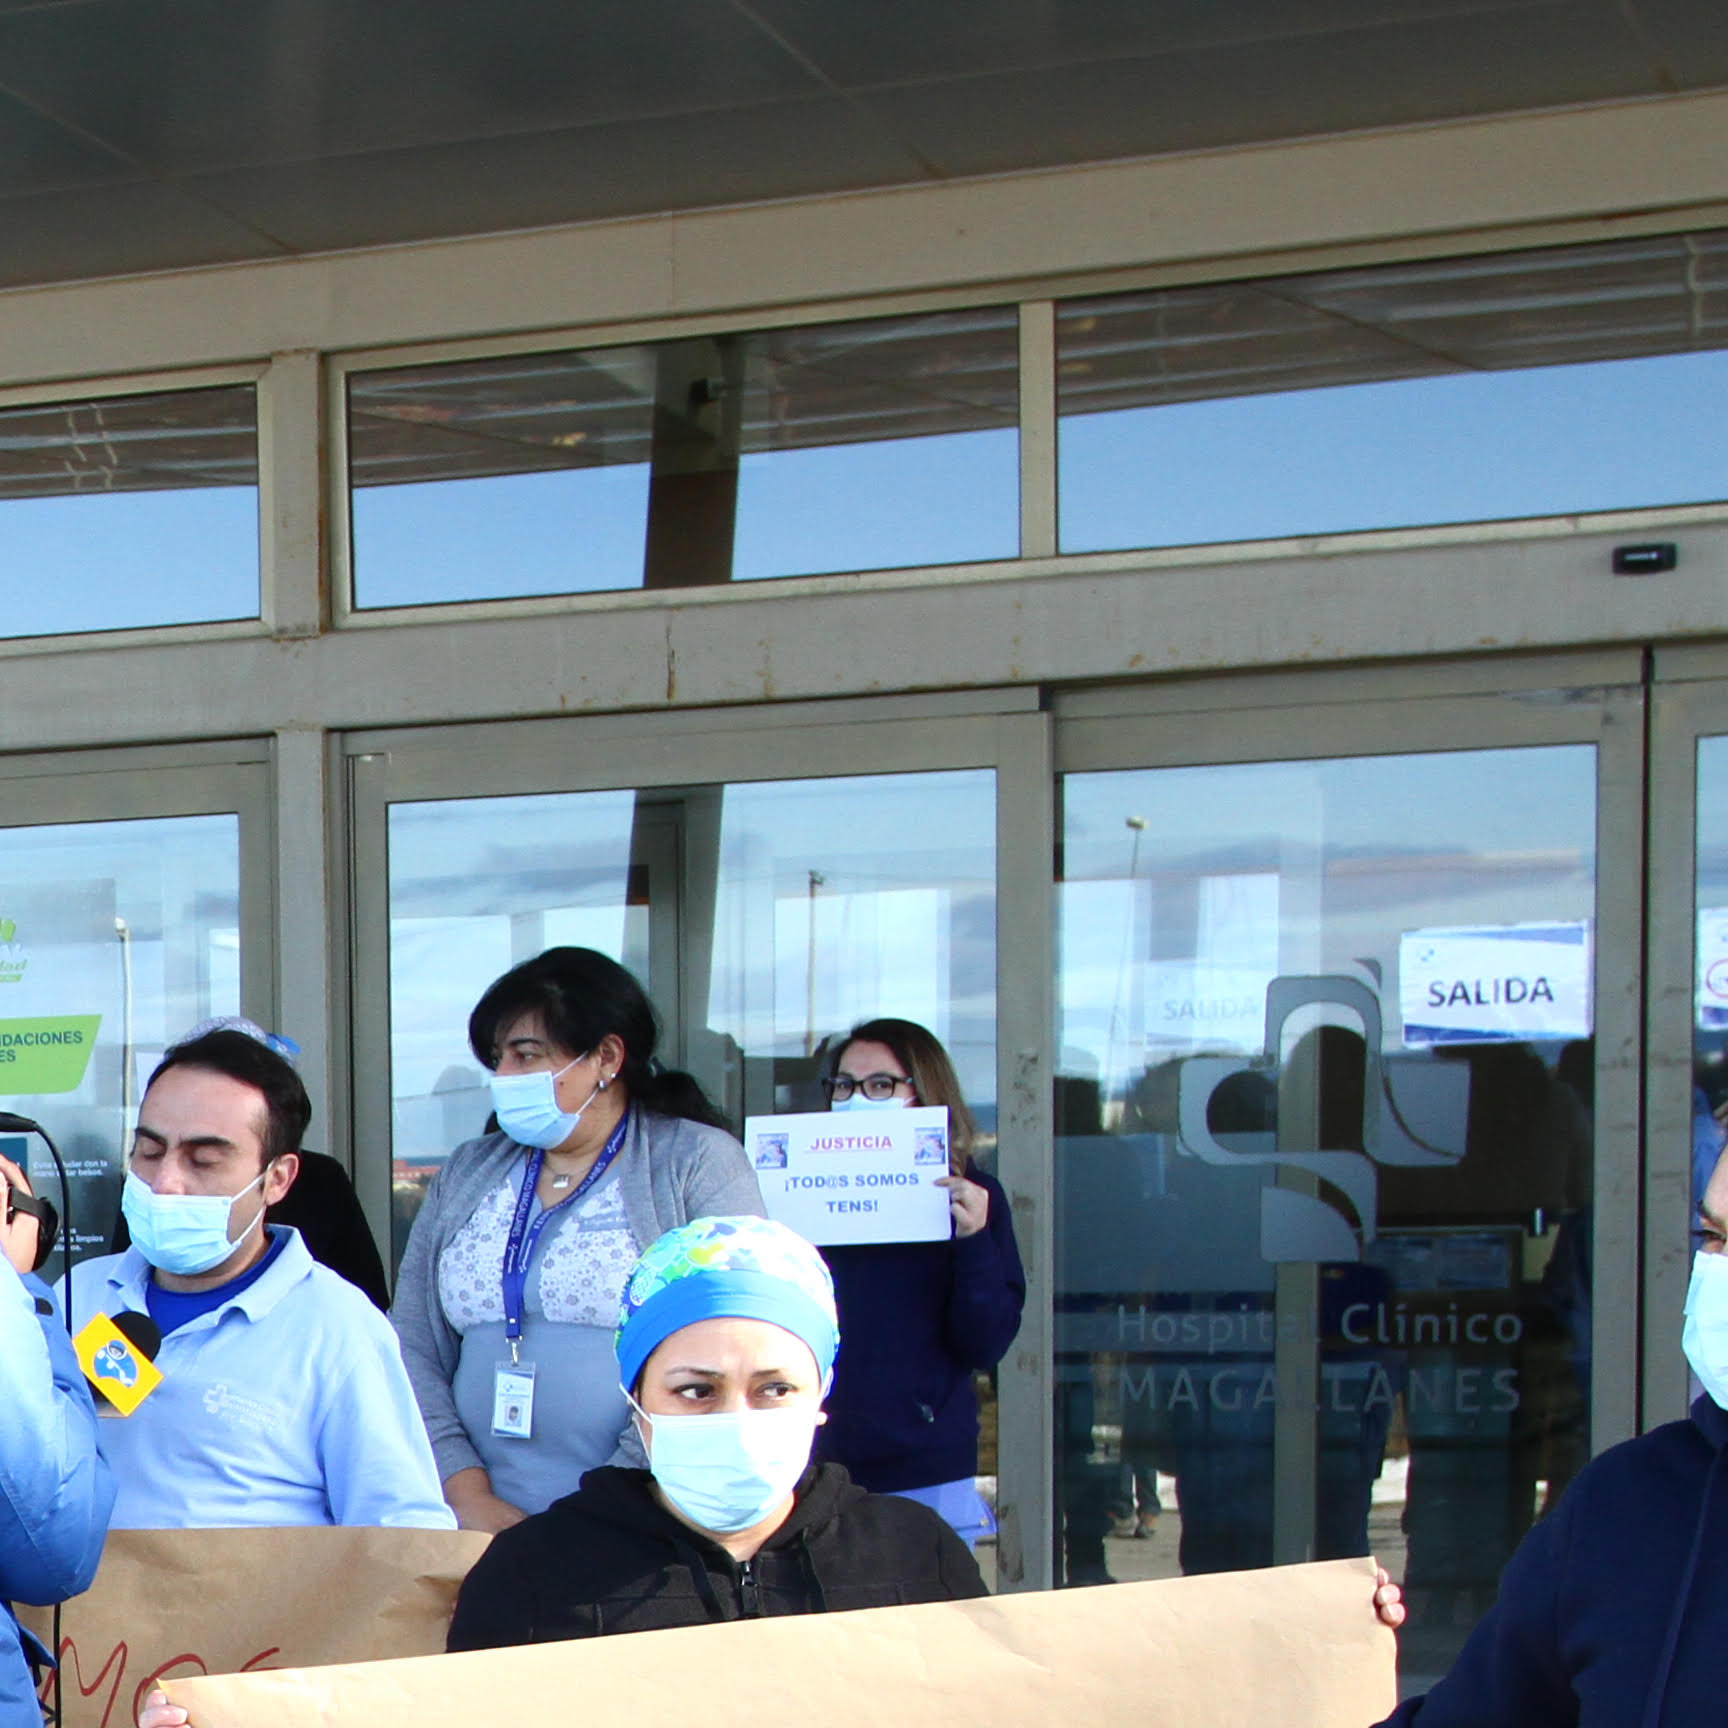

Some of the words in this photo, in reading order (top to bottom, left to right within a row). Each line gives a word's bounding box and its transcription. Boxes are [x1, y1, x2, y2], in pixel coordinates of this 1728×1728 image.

[1427, 976, 1554, 1008] SALIDA
[810, 1136, 892, 1151] JUSTICIA
[855, 1173, 919, 1187] SOMOS
[826, 1200, 878, 1213] TENS!
[1117, 1303, 1323, 1354] Hospital
[1341, 1302, 1523, 1345] Clínico
[1117, 1367, 1521, 1414] MAGALANES
